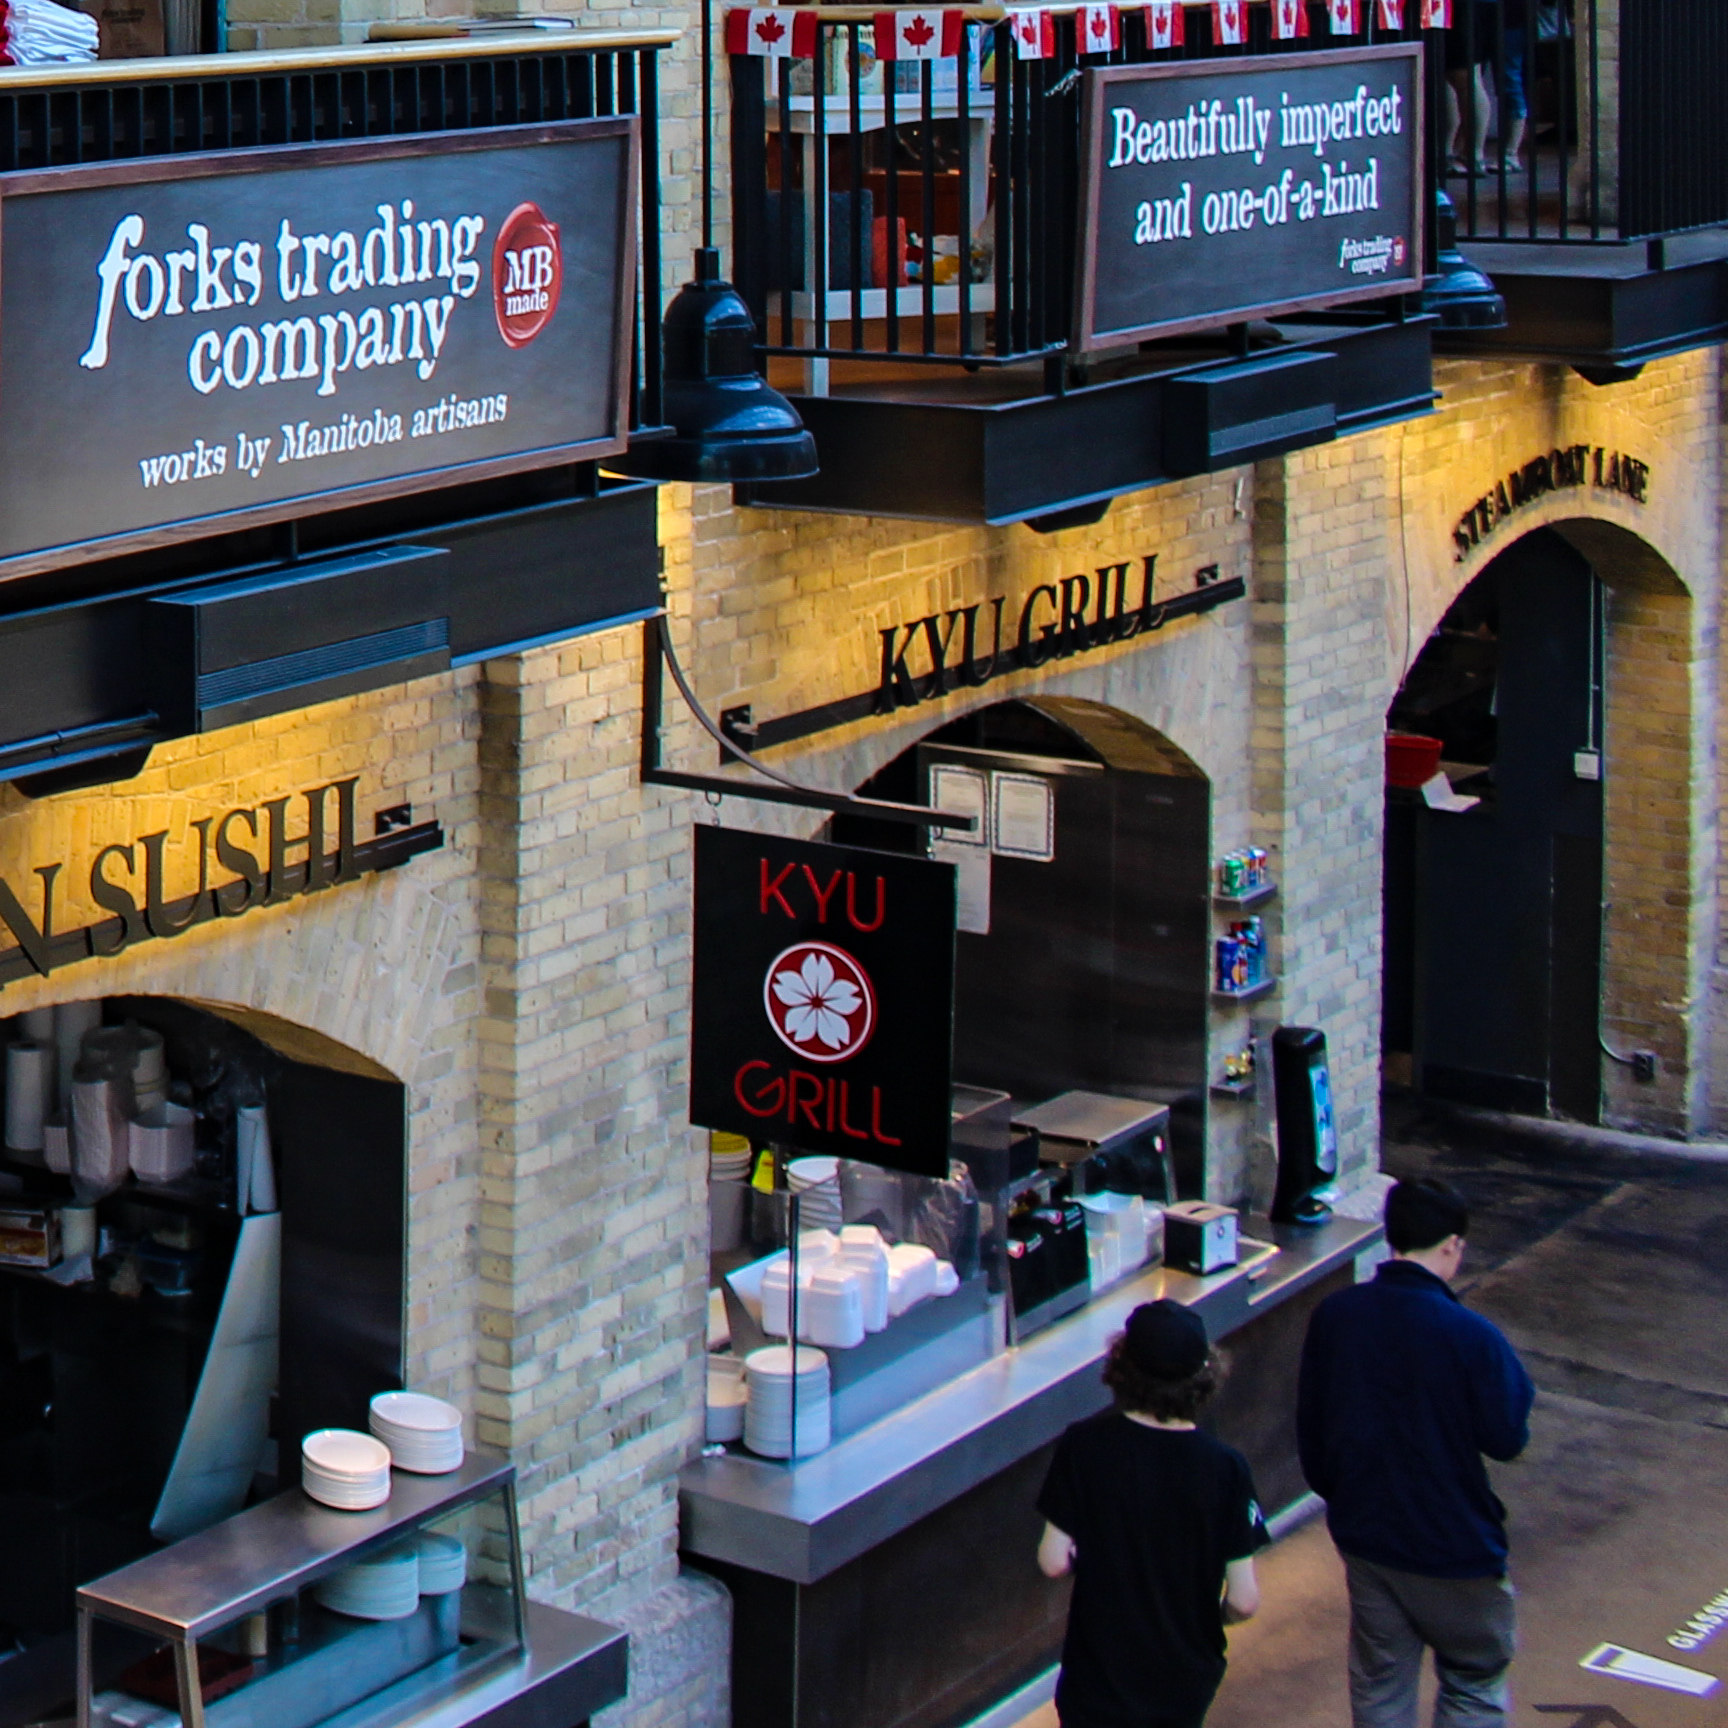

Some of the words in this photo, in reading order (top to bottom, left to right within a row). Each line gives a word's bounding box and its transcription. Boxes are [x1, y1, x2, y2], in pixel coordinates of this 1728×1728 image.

[1107, 95, 1272, 168] Beautifully
[1279, 84, 1402, 157] imperfect
[1134, 181, 1193, 245] and
[1202, 157, 1380, 236] one-of-a-kind
[79, 213, 263, 370] forks
[276, 198, 485, 303] trading
[503, 245, 554, 294] MB
[1363, 234, 1393, 256] trading
[188, 293, 455, 397] company
[505, 288, 550, 317] made
[139, 440, 227, 489] works
[236, 433, 272, 478] by
[277, 409, 405, 465] Manitoba
[411, 392, 508, 439] artisans
[1452, 444, 1591, 562] STEAMBOAT
[1593, 447, 1650, 504] LANE
[872, 595, 1006, 716] KYU
[1016, 553, 1170, 669] GRILL
[88, 776, 363, 958] SUSHI
[759, 857, 885, 933] KYU
[733, 1059, 903, 1146] GRILL
[1665, 1588, 1728, 1651] GLASSW
